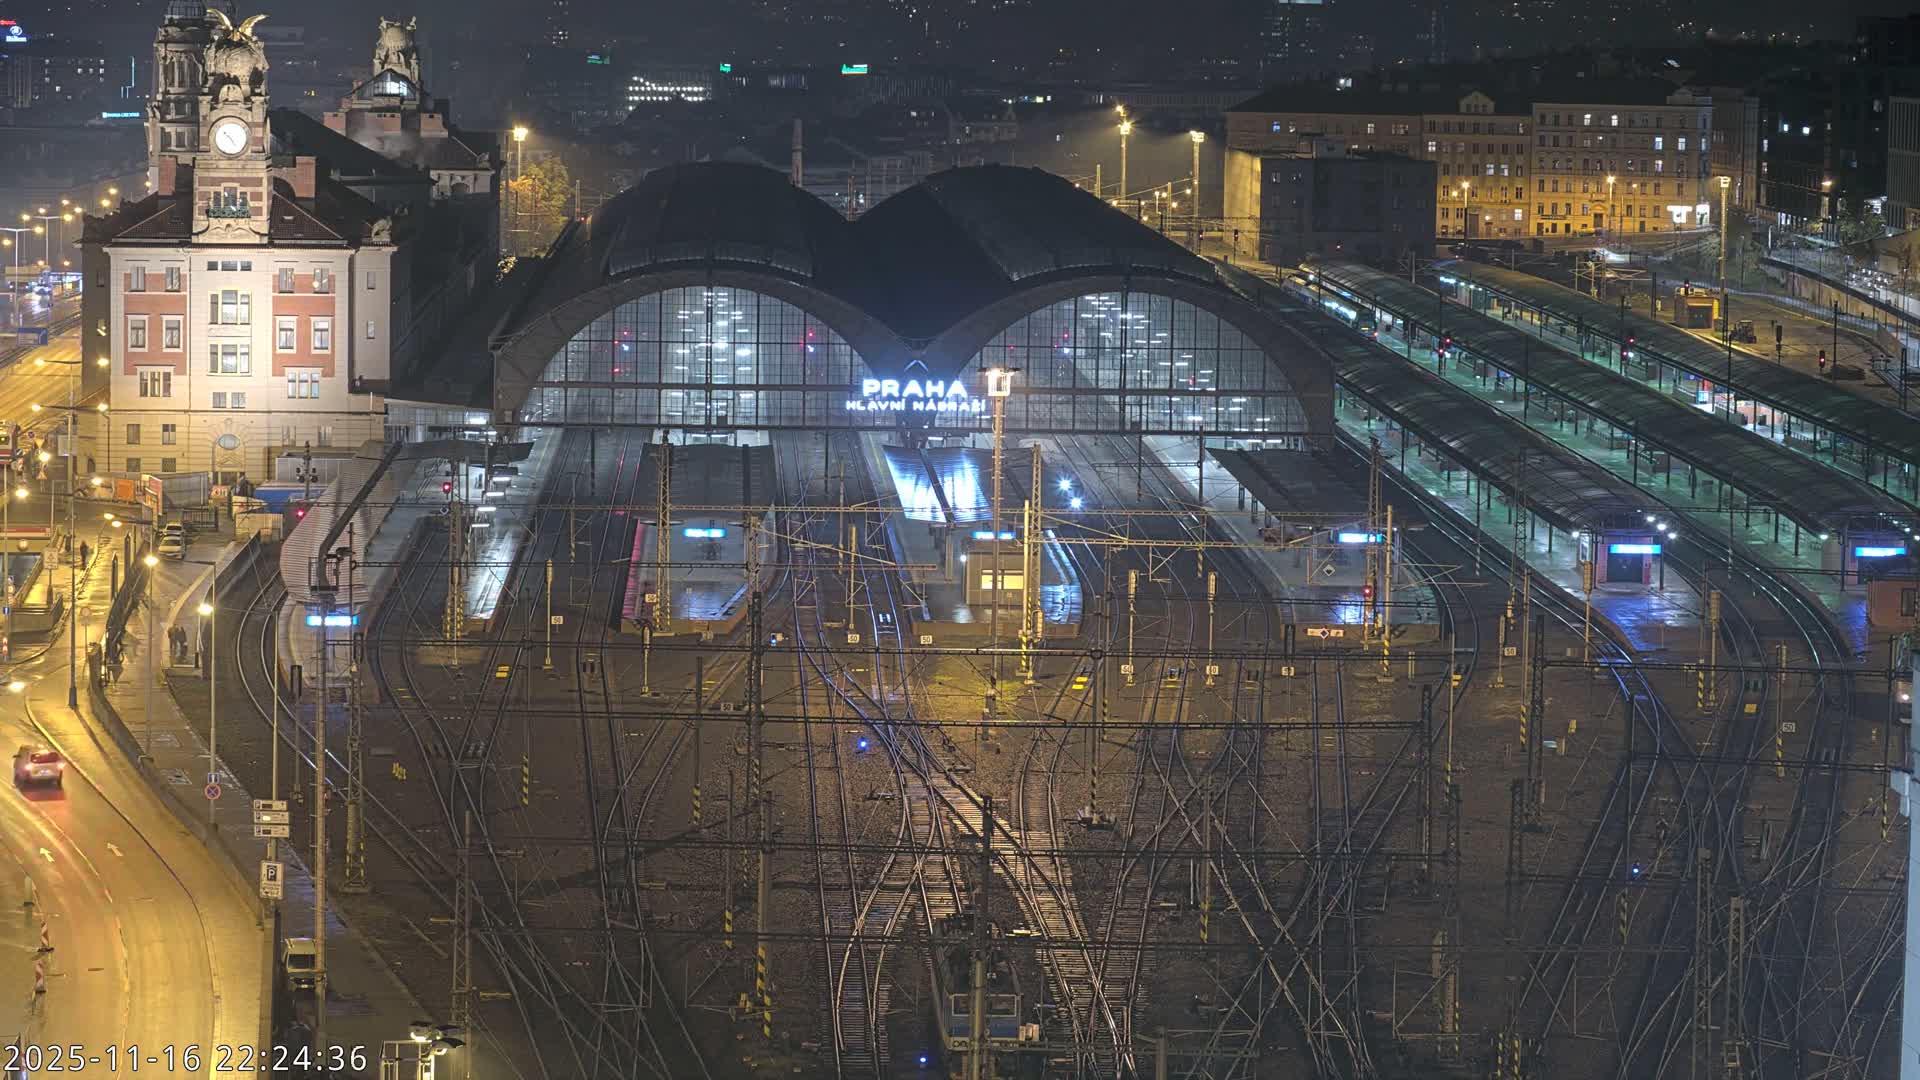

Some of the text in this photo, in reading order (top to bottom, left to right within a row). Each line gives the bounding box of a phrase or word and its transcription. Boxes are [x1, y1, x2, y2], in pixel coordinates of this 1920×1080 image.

[863, 379, 968, 398] PRAHA
[846, 399, 906, 411] HLAVNÍ
[268, 869, 276, 879] P
